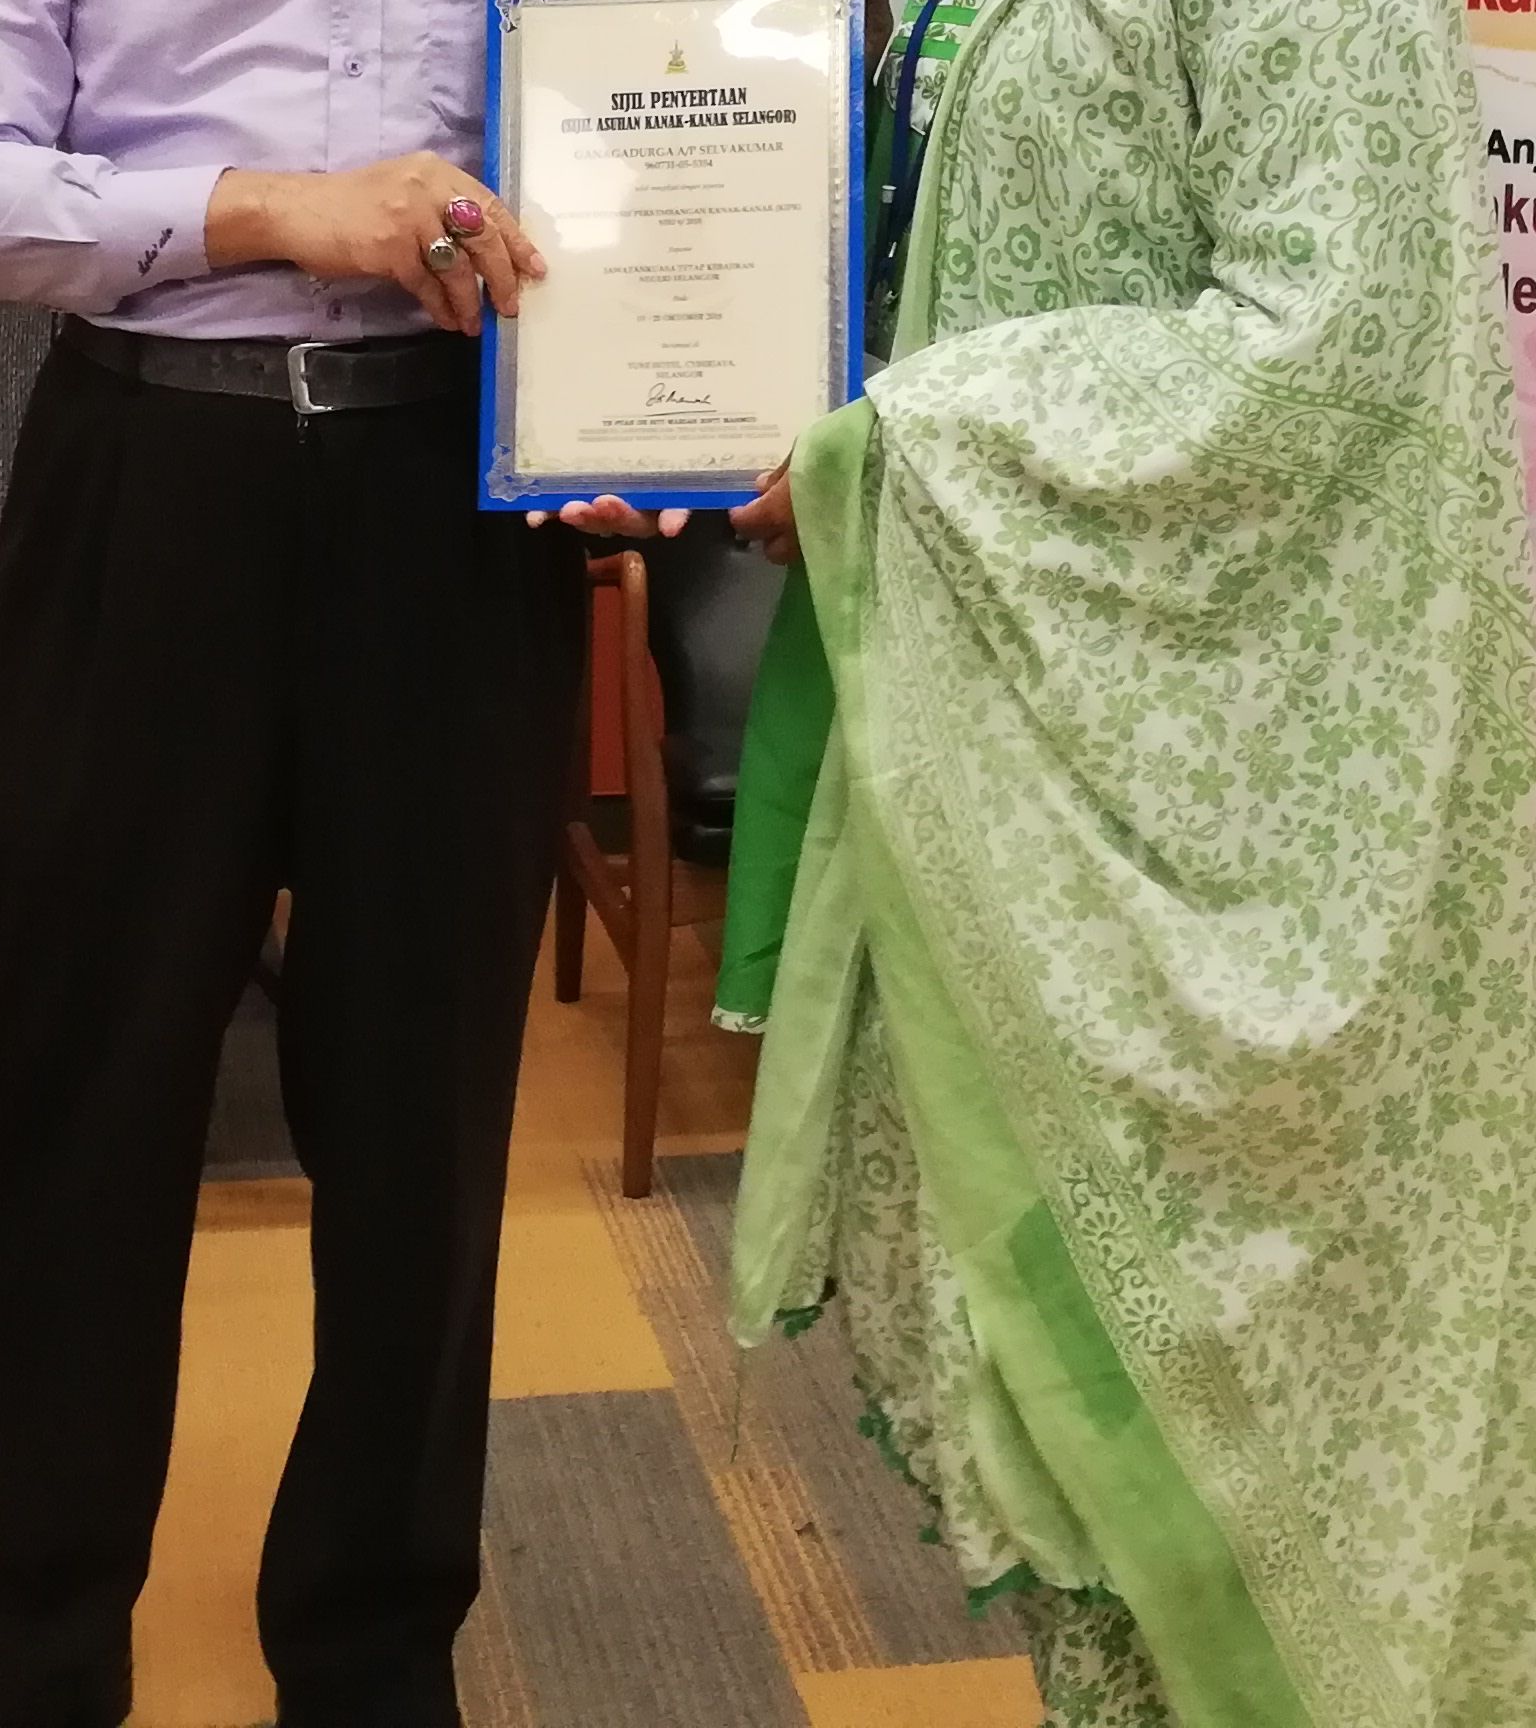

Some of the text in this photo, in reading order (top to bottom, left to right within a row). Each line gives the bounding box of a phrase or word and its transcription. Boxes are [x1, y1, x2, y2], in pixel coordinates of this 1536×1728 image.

[611, 87, 747, 113] SIJIL PENYERTAAN
[596, 116, 641, 132] ASUHAN
[644, 111, 729, 130] KANAK-KANAK
[732, 109, 797, 126] SELANGOR)
